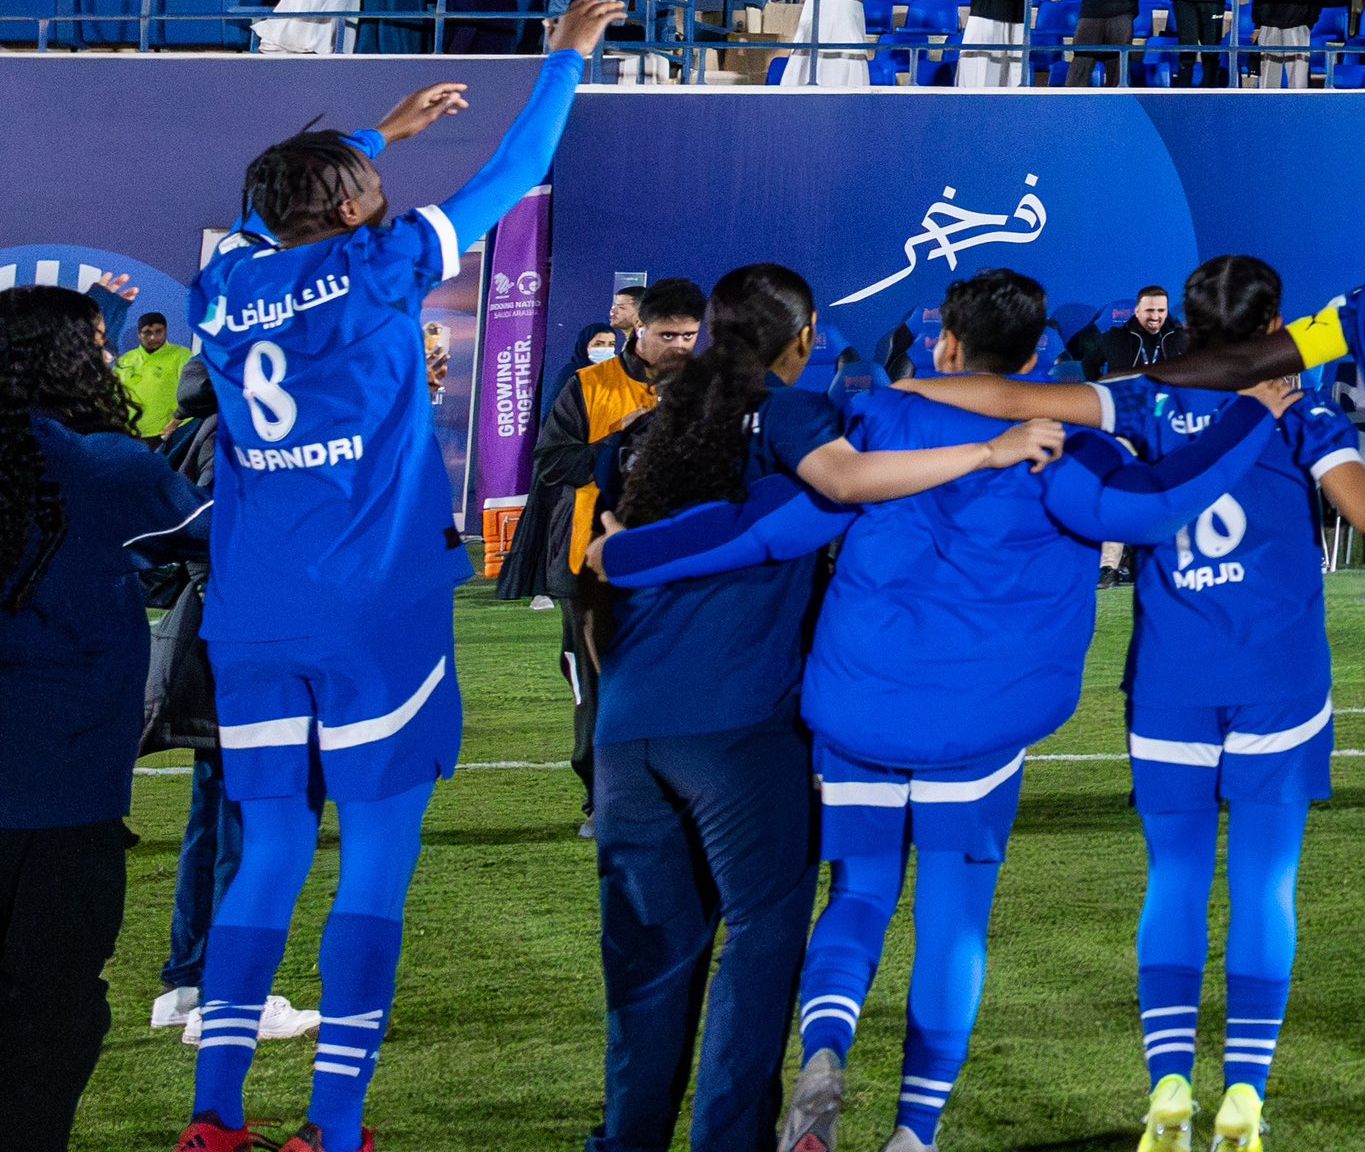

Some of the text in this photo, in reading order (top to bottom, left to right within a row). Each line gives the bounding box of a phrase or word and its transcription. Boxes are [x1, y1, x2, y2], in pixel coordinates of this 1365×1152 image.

[242, 340, 298, 443] 8
[496, 346, 515, 438] GROWING.
[514, 334, 532, 436] TOGETHER.
[1173, 561, 1245, 592] MAJD
